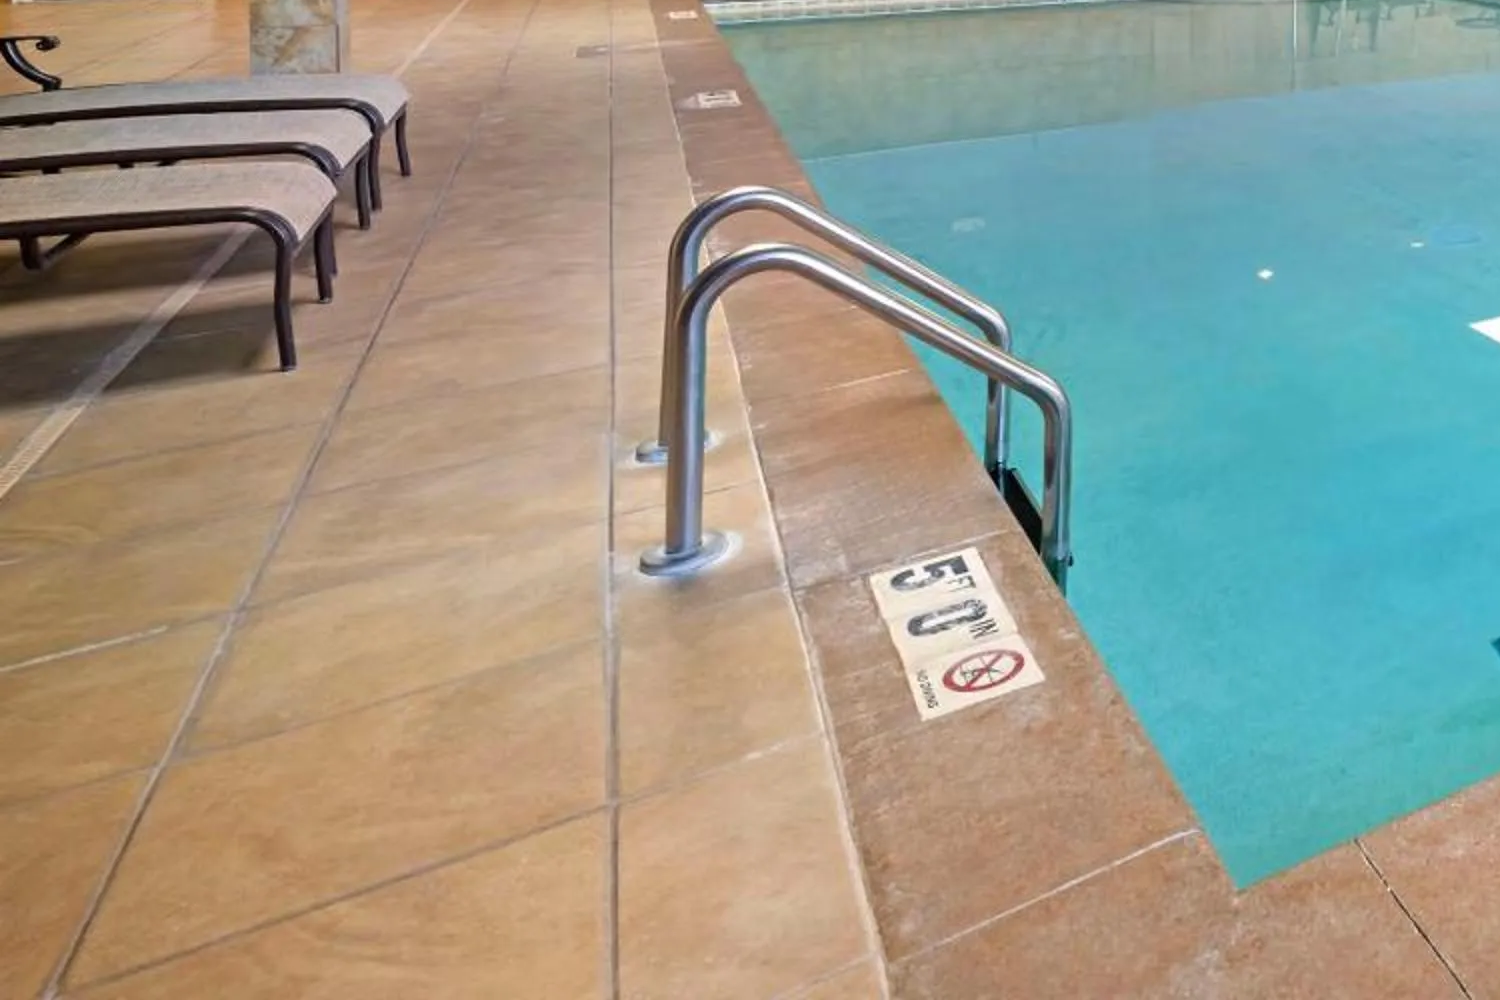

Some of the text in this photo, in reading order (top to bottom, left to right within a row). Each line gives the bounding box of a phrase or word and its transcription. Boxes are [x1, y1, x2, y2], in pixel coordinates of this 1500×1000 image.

[890, 555, 969, 592] 5
[906, 599, 989, 637] 0
[969, 618, 1000, 640] IN
